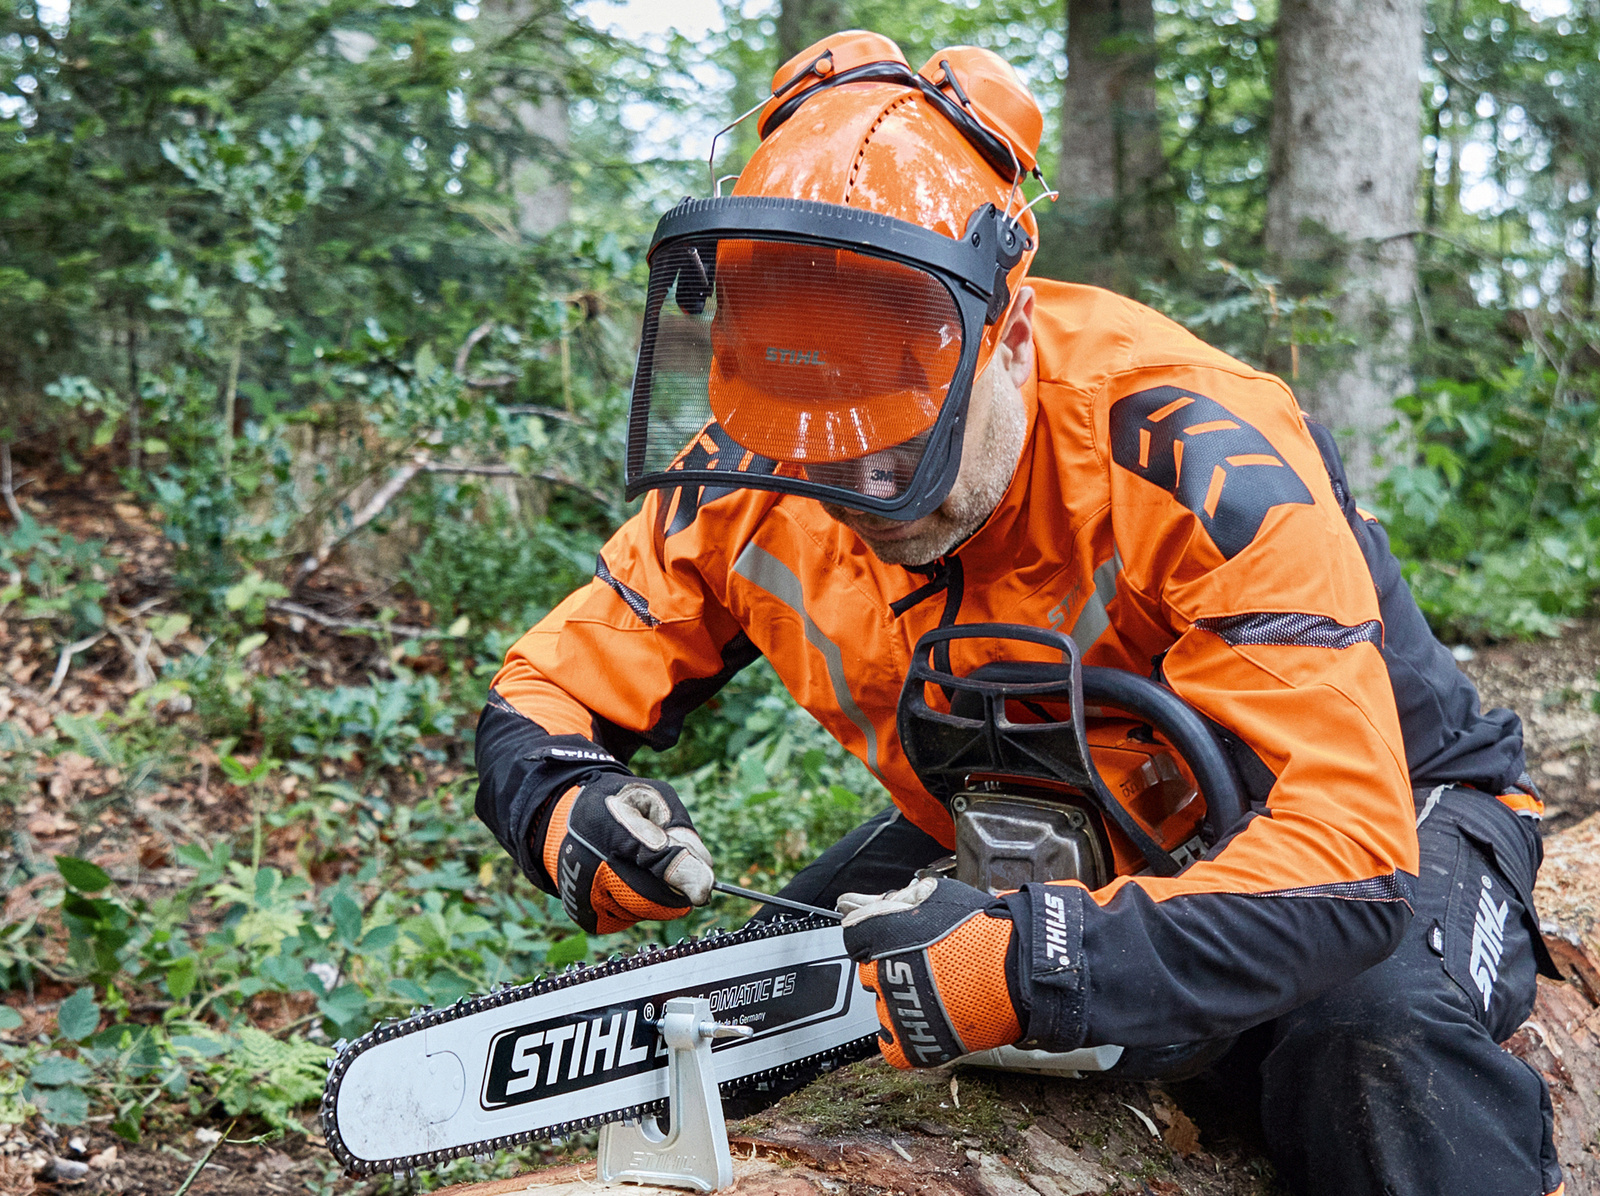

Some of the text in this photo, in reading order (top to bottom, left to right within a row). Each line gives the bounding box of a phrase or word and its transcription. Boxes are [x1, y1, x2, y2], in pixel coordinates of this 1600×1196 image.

[765, 347, 826, 366] STIHL
[871, 469, 894, 482] 3M
[1047, 576, 1083, 631] STIH
[561, 857, 581, 921] TIHL
[1044, 892, 1067, 959] STIHL
[1470, 888, 1509, 1011] STIHL
[772, 972, 797, 998] ES
[885, 959, 943, 1063] STIHL
[739, 1012, 766, 1025] Germany
[505, 1009, 649, 1097] STIHL
[629, 1151, 693, 1172] STIHL
